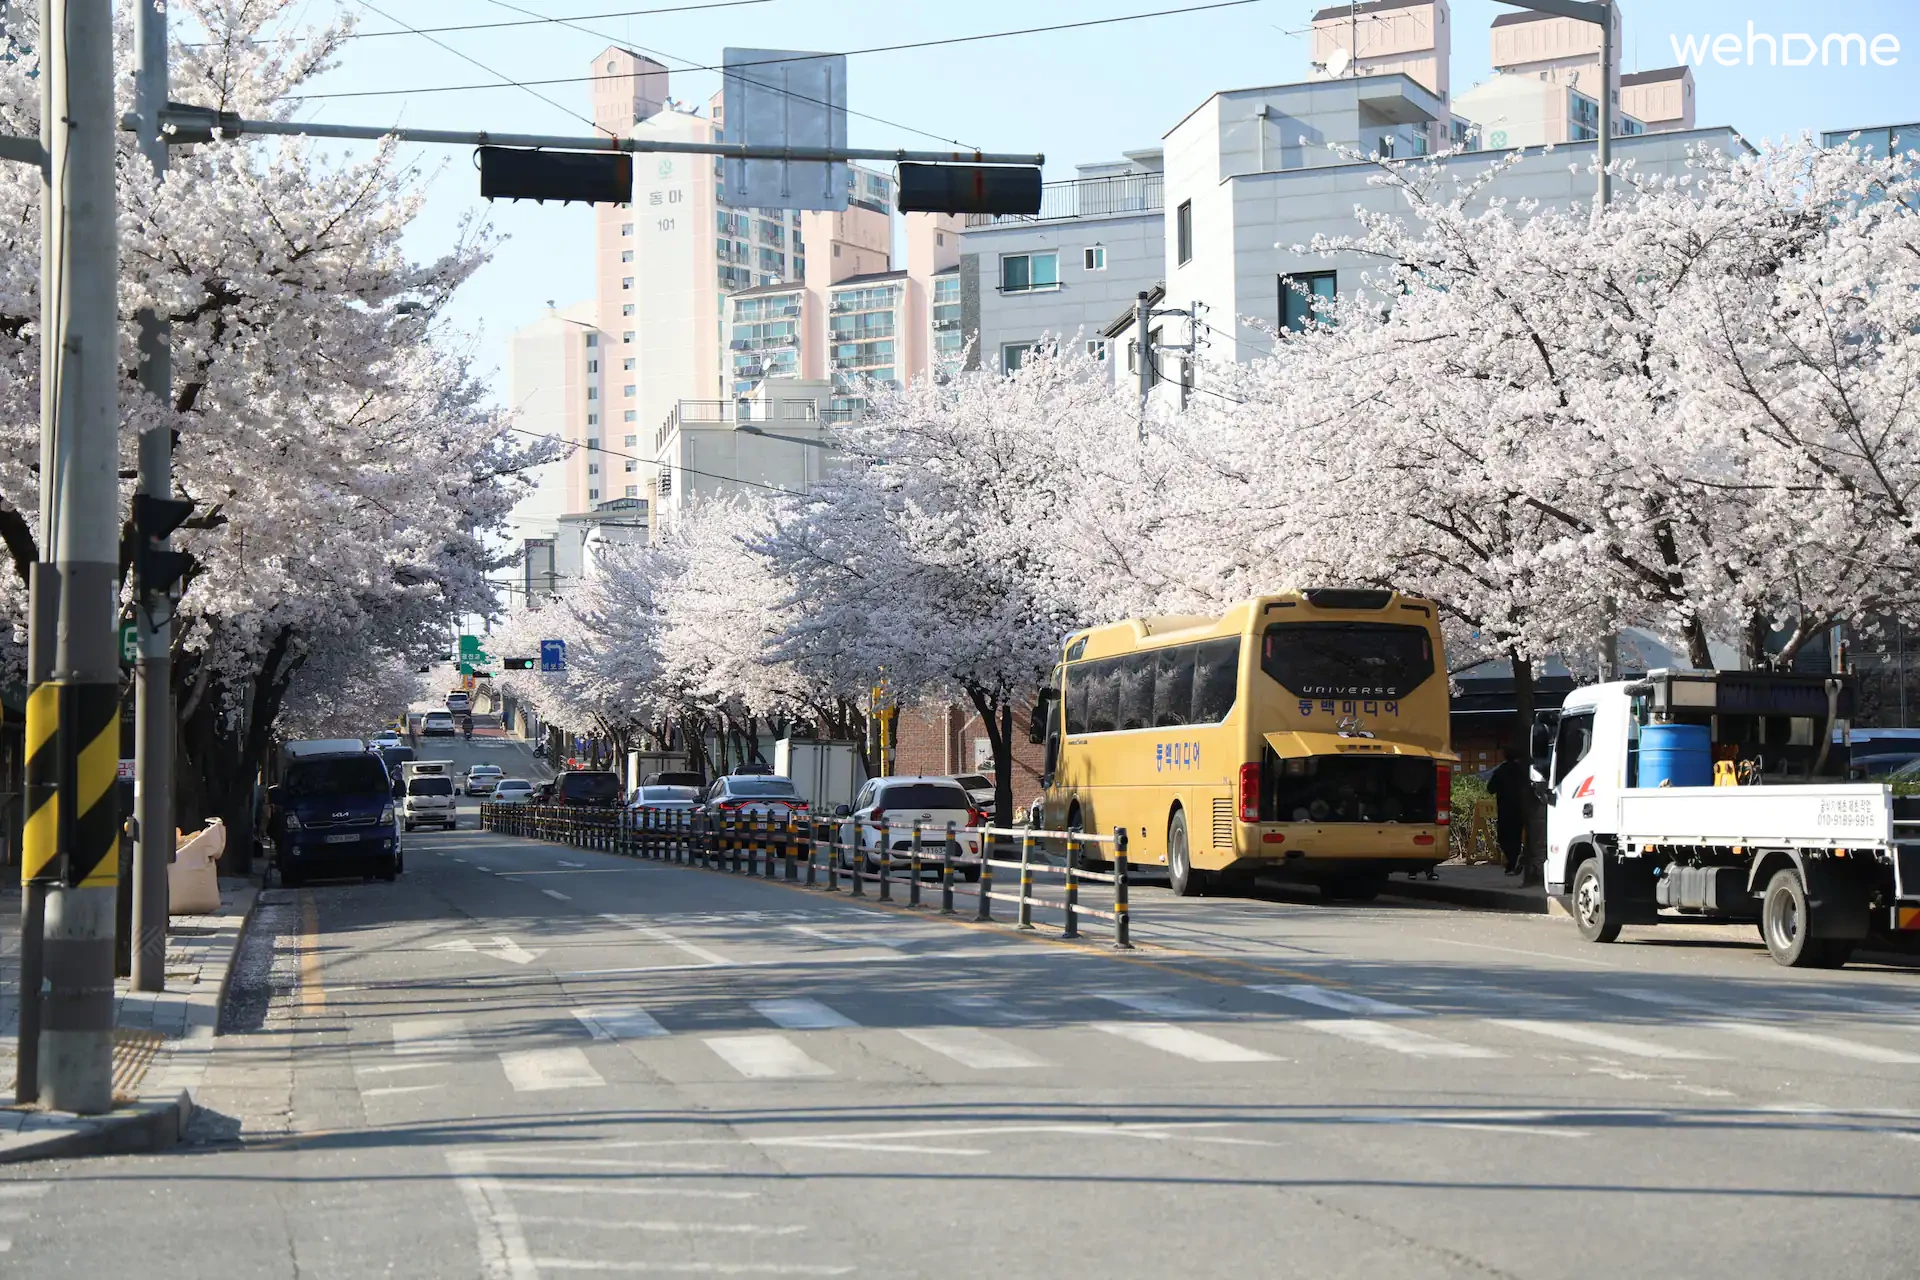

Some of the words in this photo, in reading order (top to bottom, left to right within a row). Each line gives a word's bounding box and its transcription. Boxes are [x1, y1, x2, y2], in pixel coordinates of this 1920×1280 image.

[657, 218, 675, 231] 101
[1302, 685, 1396, 695] UNIVERSE
[1298, 699, 1399, 717] 동백미디어
[1156, 741, 1200, 773] 동백미디어
